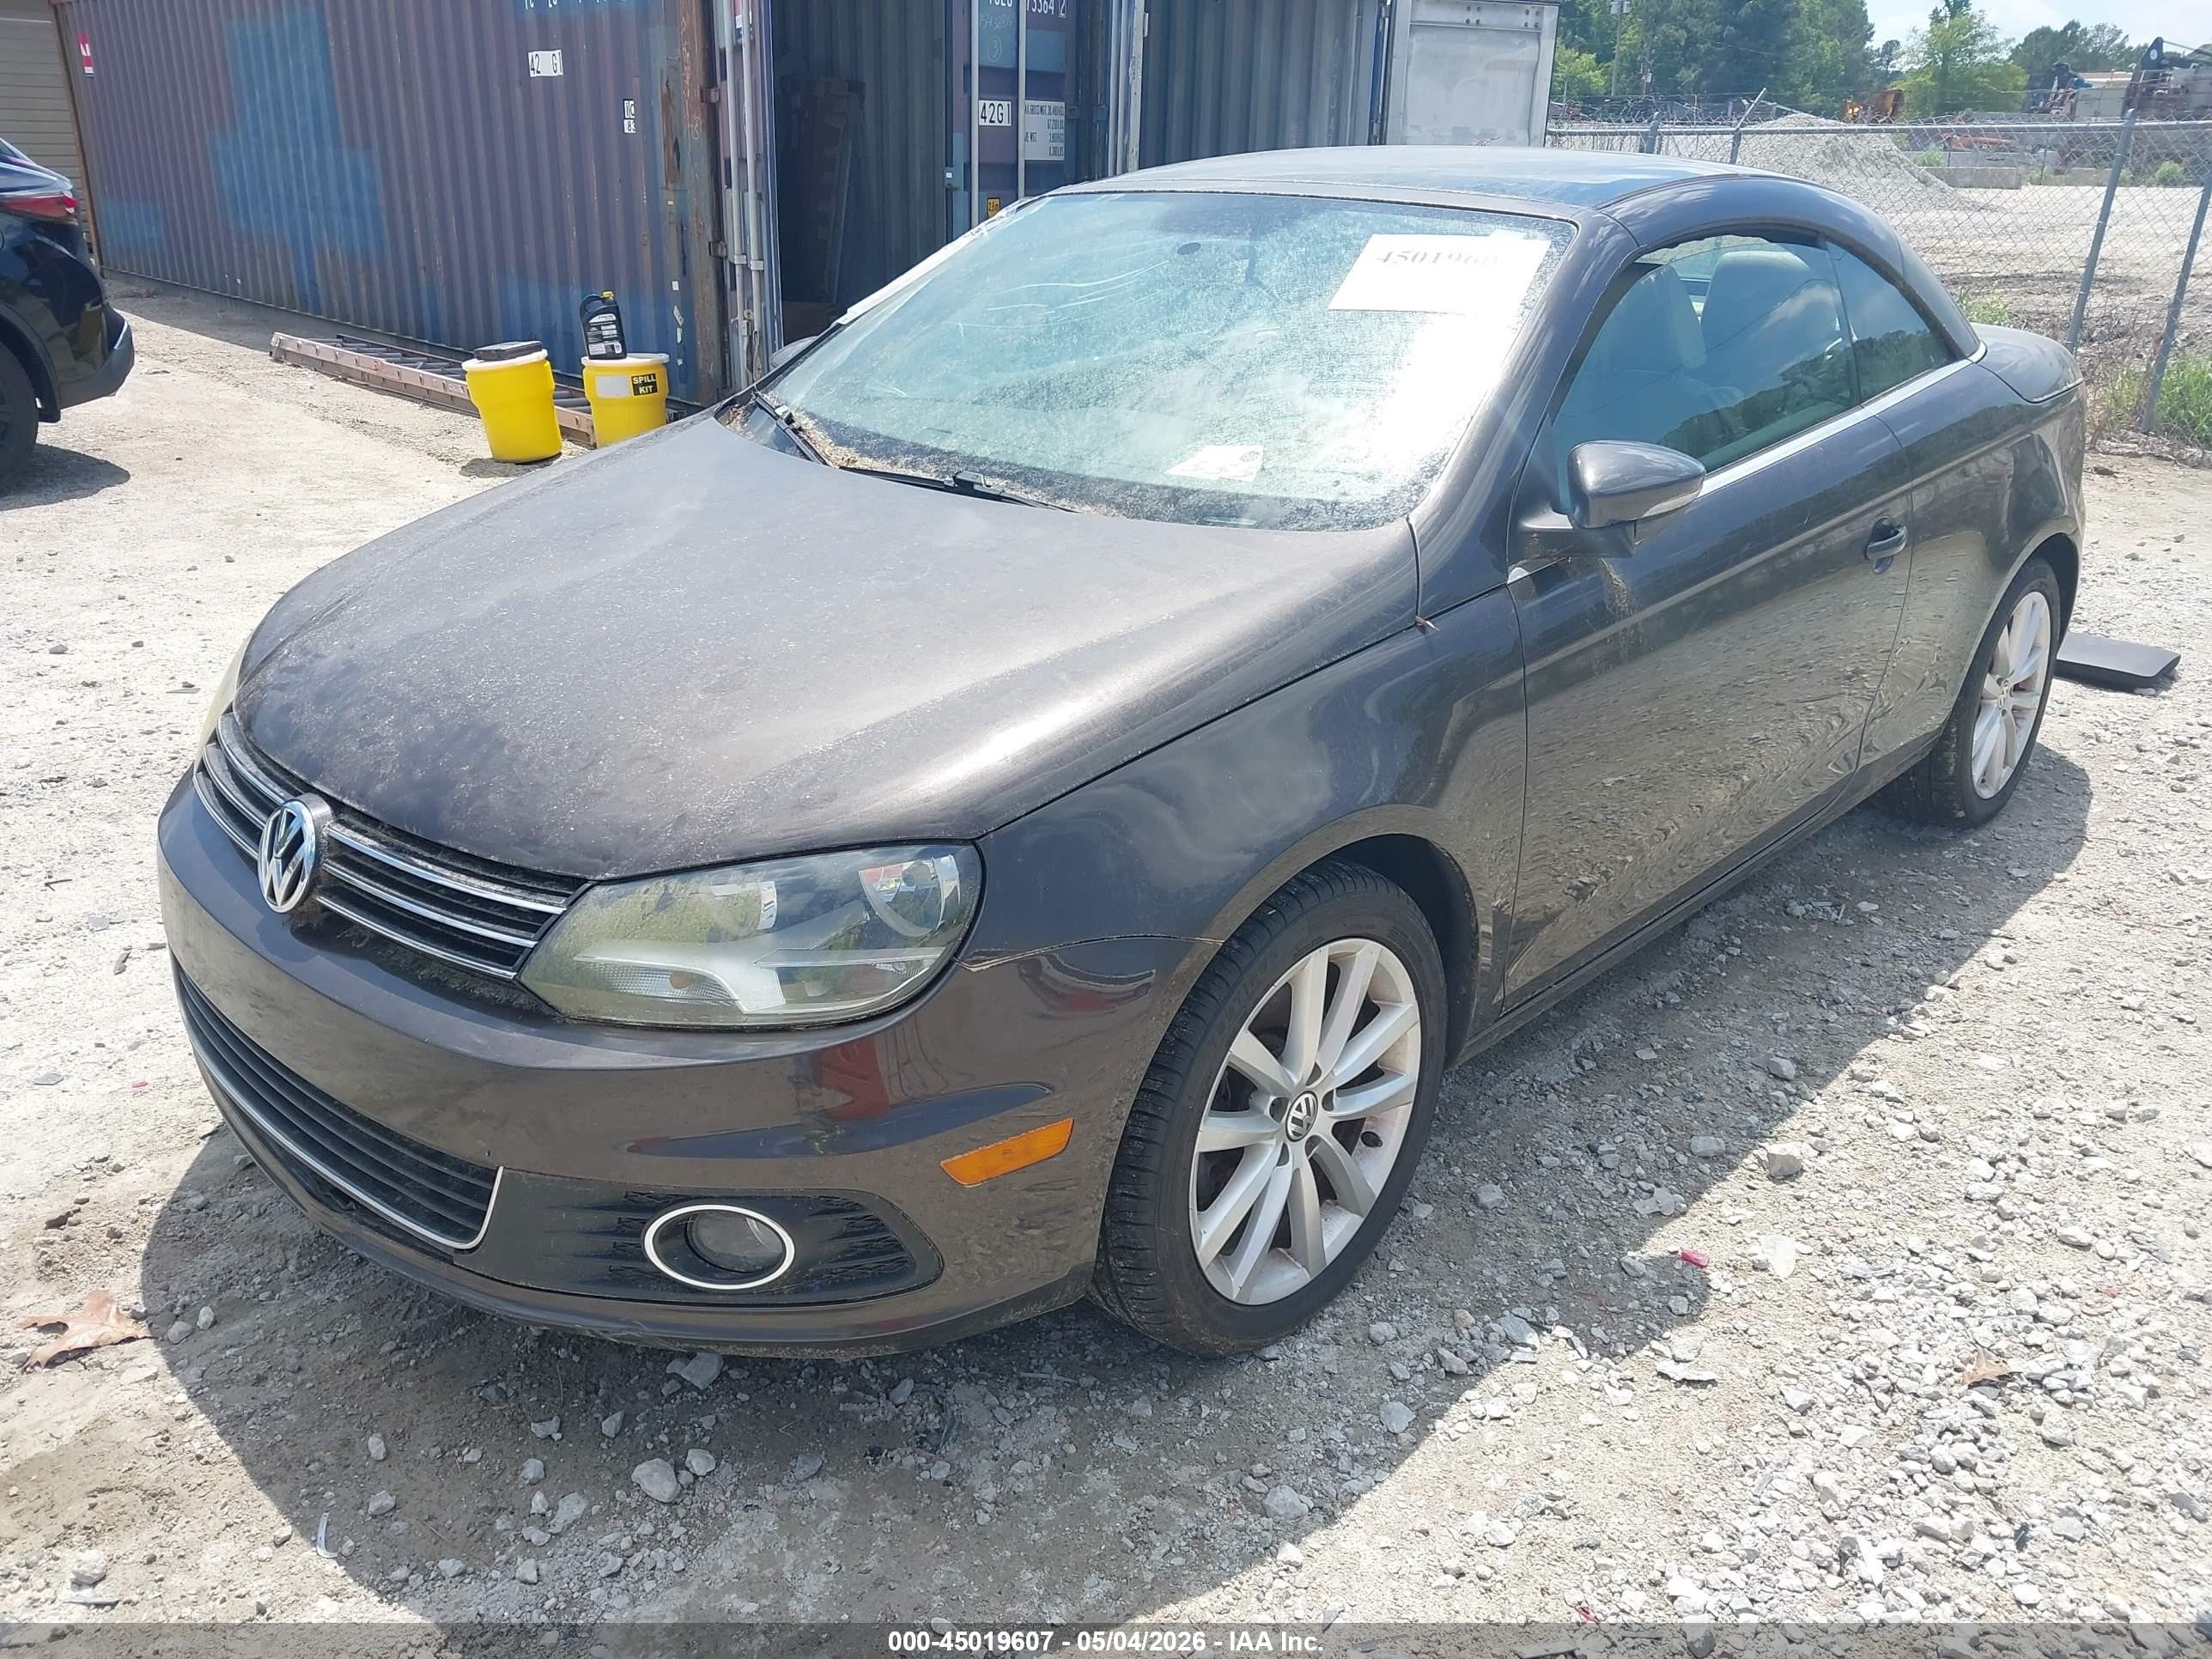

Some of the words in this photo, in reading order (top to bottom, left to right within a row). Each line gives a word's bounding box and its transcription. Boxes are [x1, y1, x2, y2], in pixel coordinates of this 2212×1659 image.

[980, 102, 1011, 124] 42G1
[633, 374, 656, 385] SPILL
[638, 385, 653, 394] KIT
